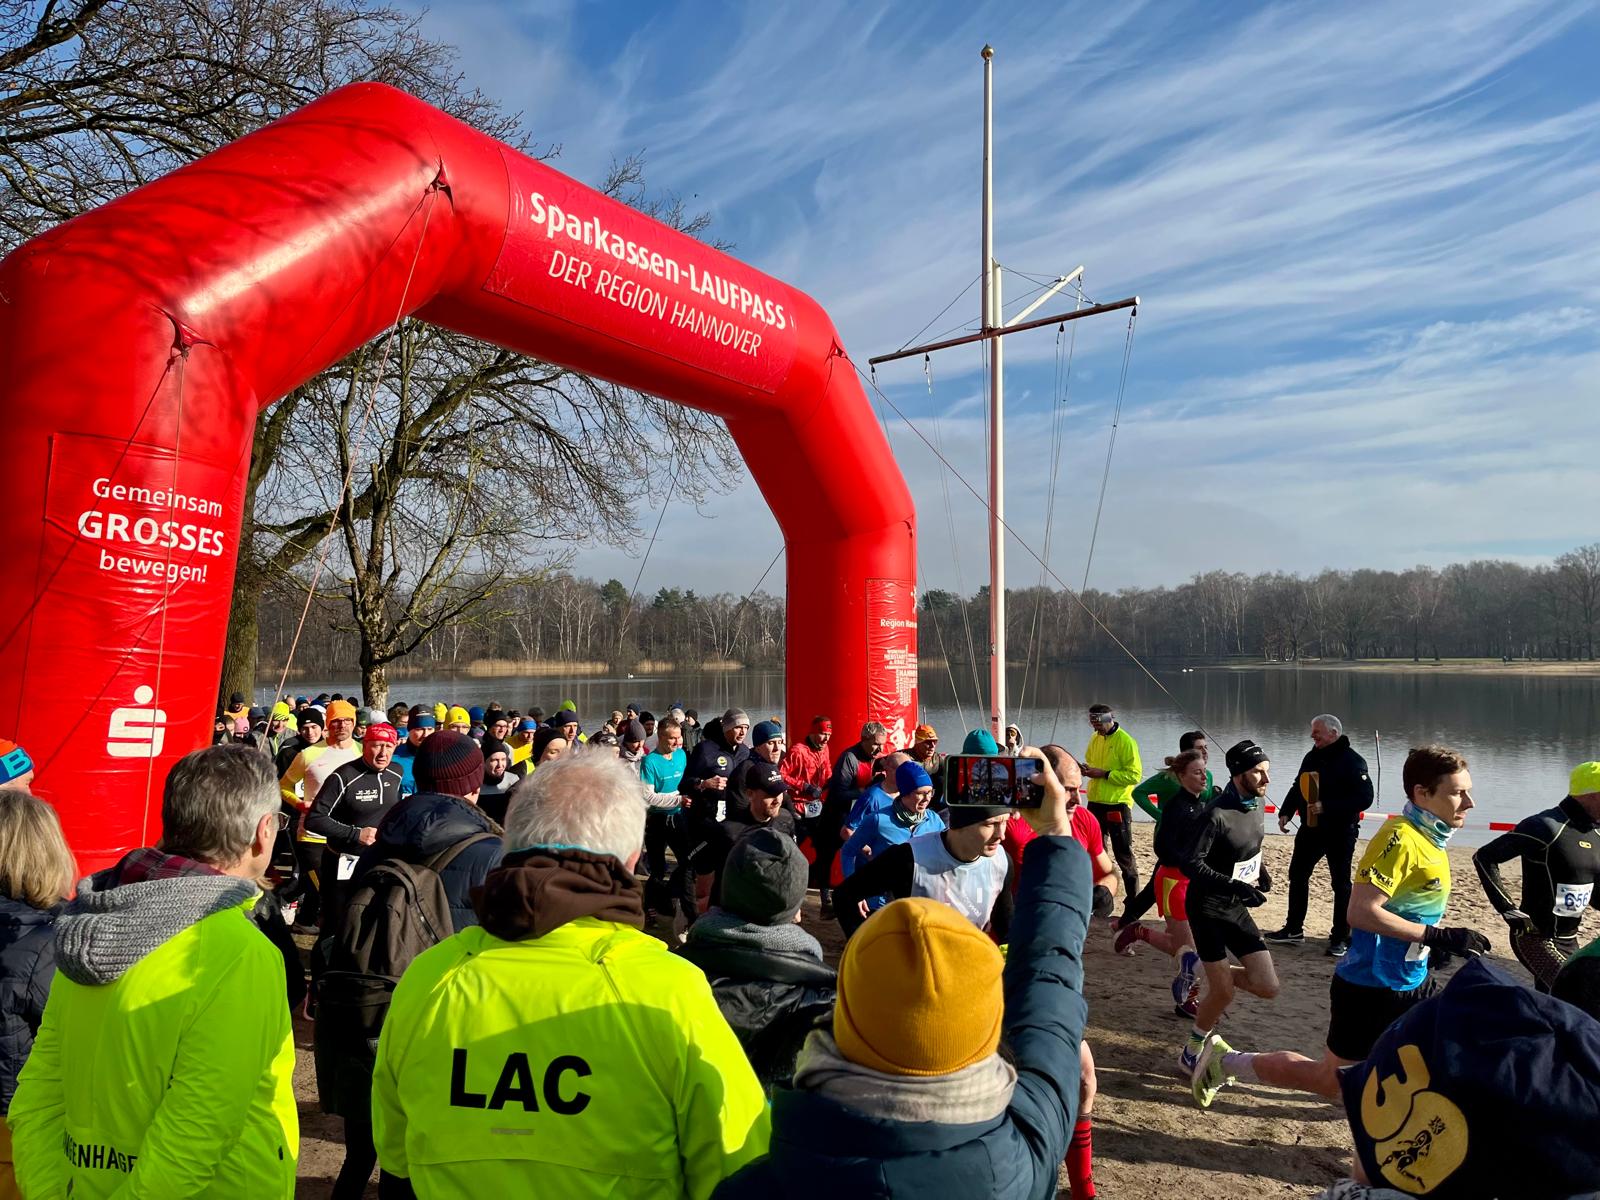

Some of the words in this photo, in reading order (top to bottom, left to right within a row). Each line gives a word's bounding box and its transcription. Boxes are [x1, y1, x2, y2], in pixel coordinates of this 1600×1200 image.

[530, 192, 786, 330] Sparkassen-LAUFPASS
[548, 250, 592, 290] DER
[595, 269, 668, 320] REGION
[670, 303, 762, 357] HANNOVER
[92, 478, 222, 517] Gemeinsam
[77, 511, 224, 556] GROSSES
[100, 549, 207, 583] bewegen!
[880, 619, 905, 629] Region
[450, 1048, 592, 1115] LAC
